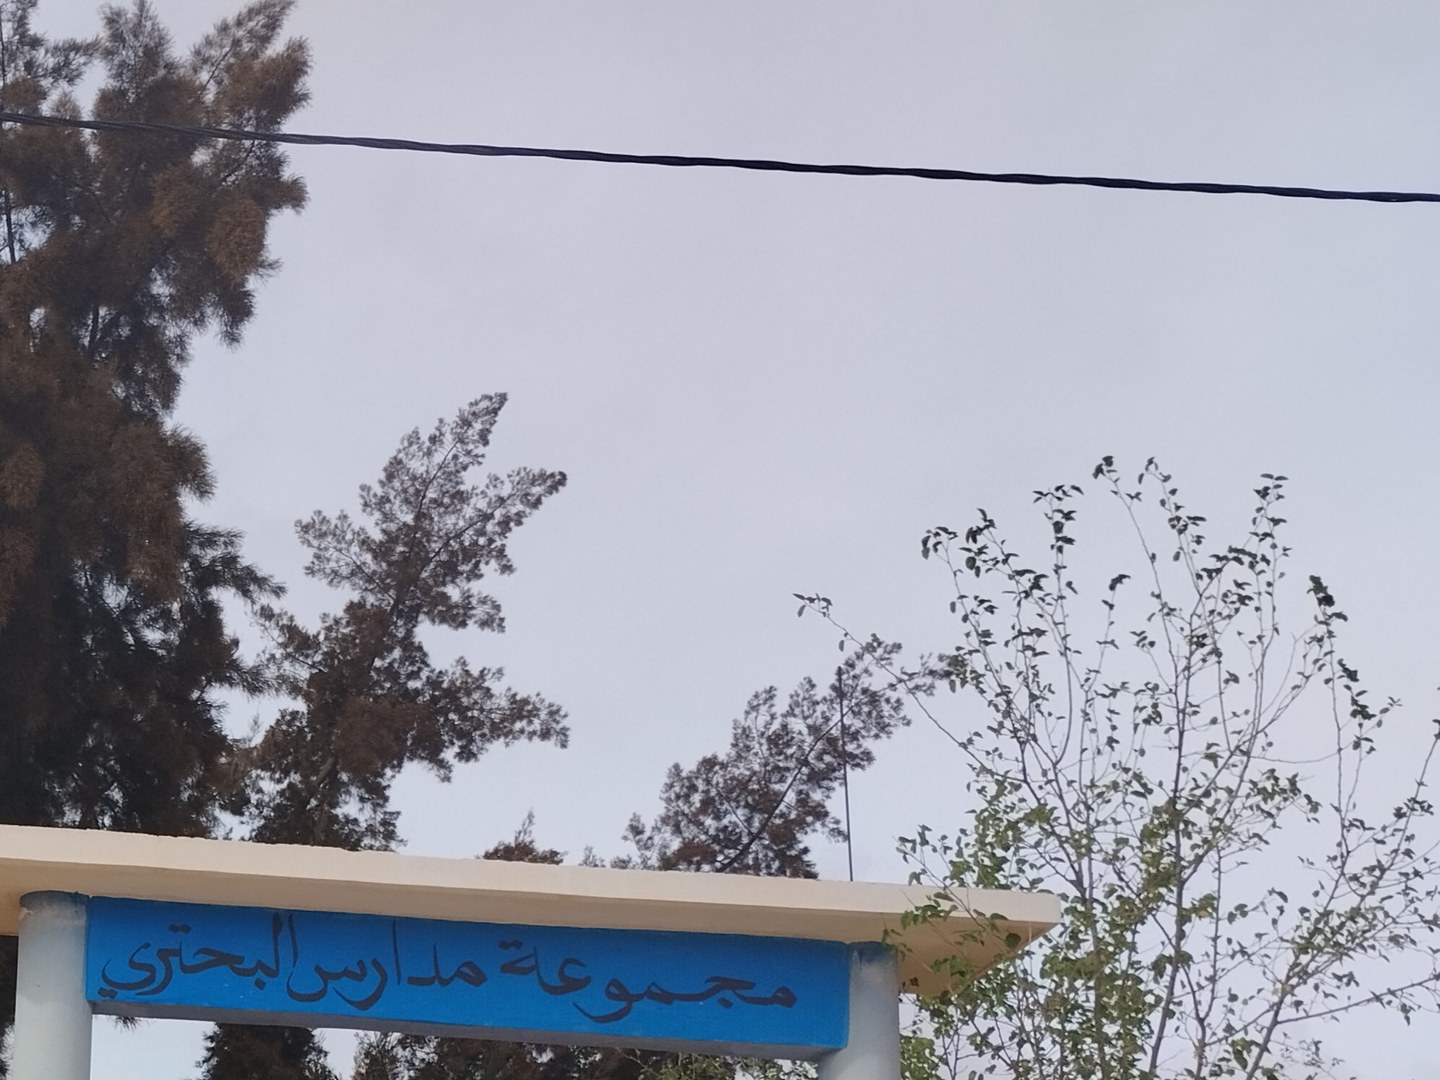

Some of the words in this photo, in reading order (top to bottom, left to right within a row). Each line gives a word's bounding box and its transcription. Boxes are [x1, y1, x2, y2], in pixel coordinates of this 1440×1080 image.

[100, 912, 298, 999] البحتري
[287, 919, 487, 1012] مدارس
[498, 937, 798, 1023] مجموعة
